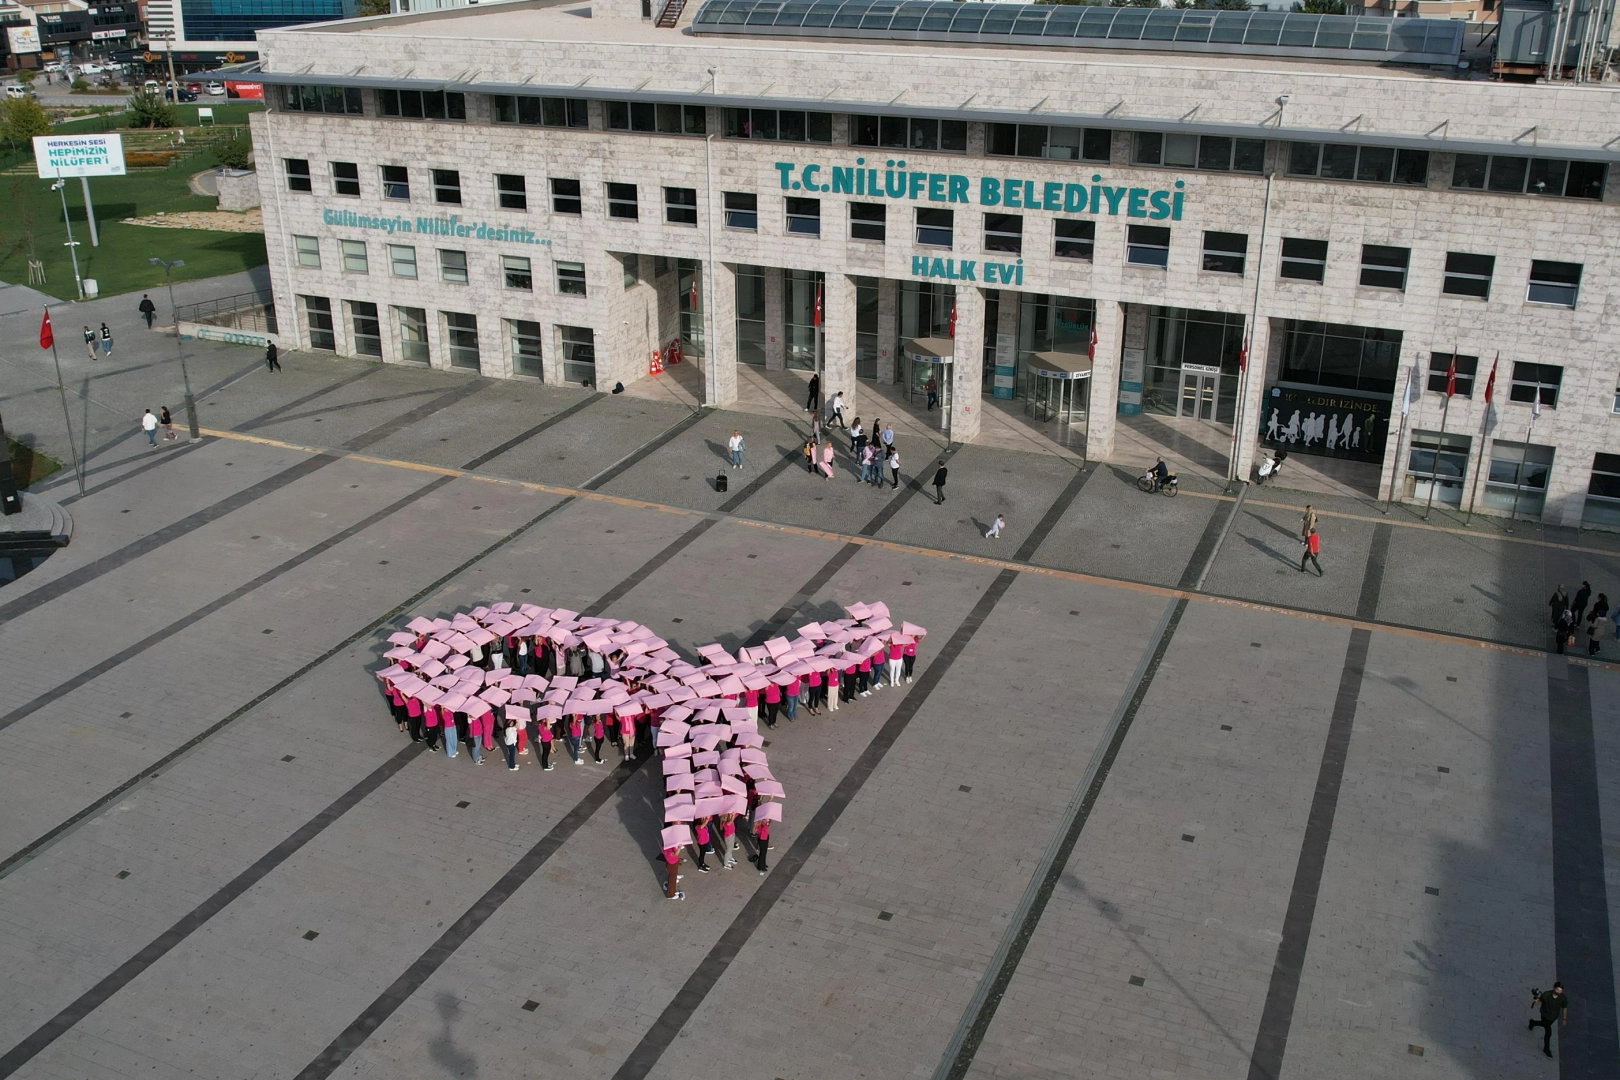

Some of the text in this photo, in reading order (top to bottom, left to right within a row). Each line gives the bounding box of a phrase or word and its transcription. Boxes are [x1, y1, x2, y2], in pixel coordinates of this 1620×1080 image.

[47, 139, 87, 147] HERKESİN
[48, 146, 107, 157] HEPİMİZİN
[50, 156, 109, 167] NİLÜFER'İ
[980, 174, 1185, 221] BELEDİYESİ
[322, 208, 552, 246] Gülümseyin Nilüfer'desiniz...
[912, 255, 1024, 285] HALK EVİ
